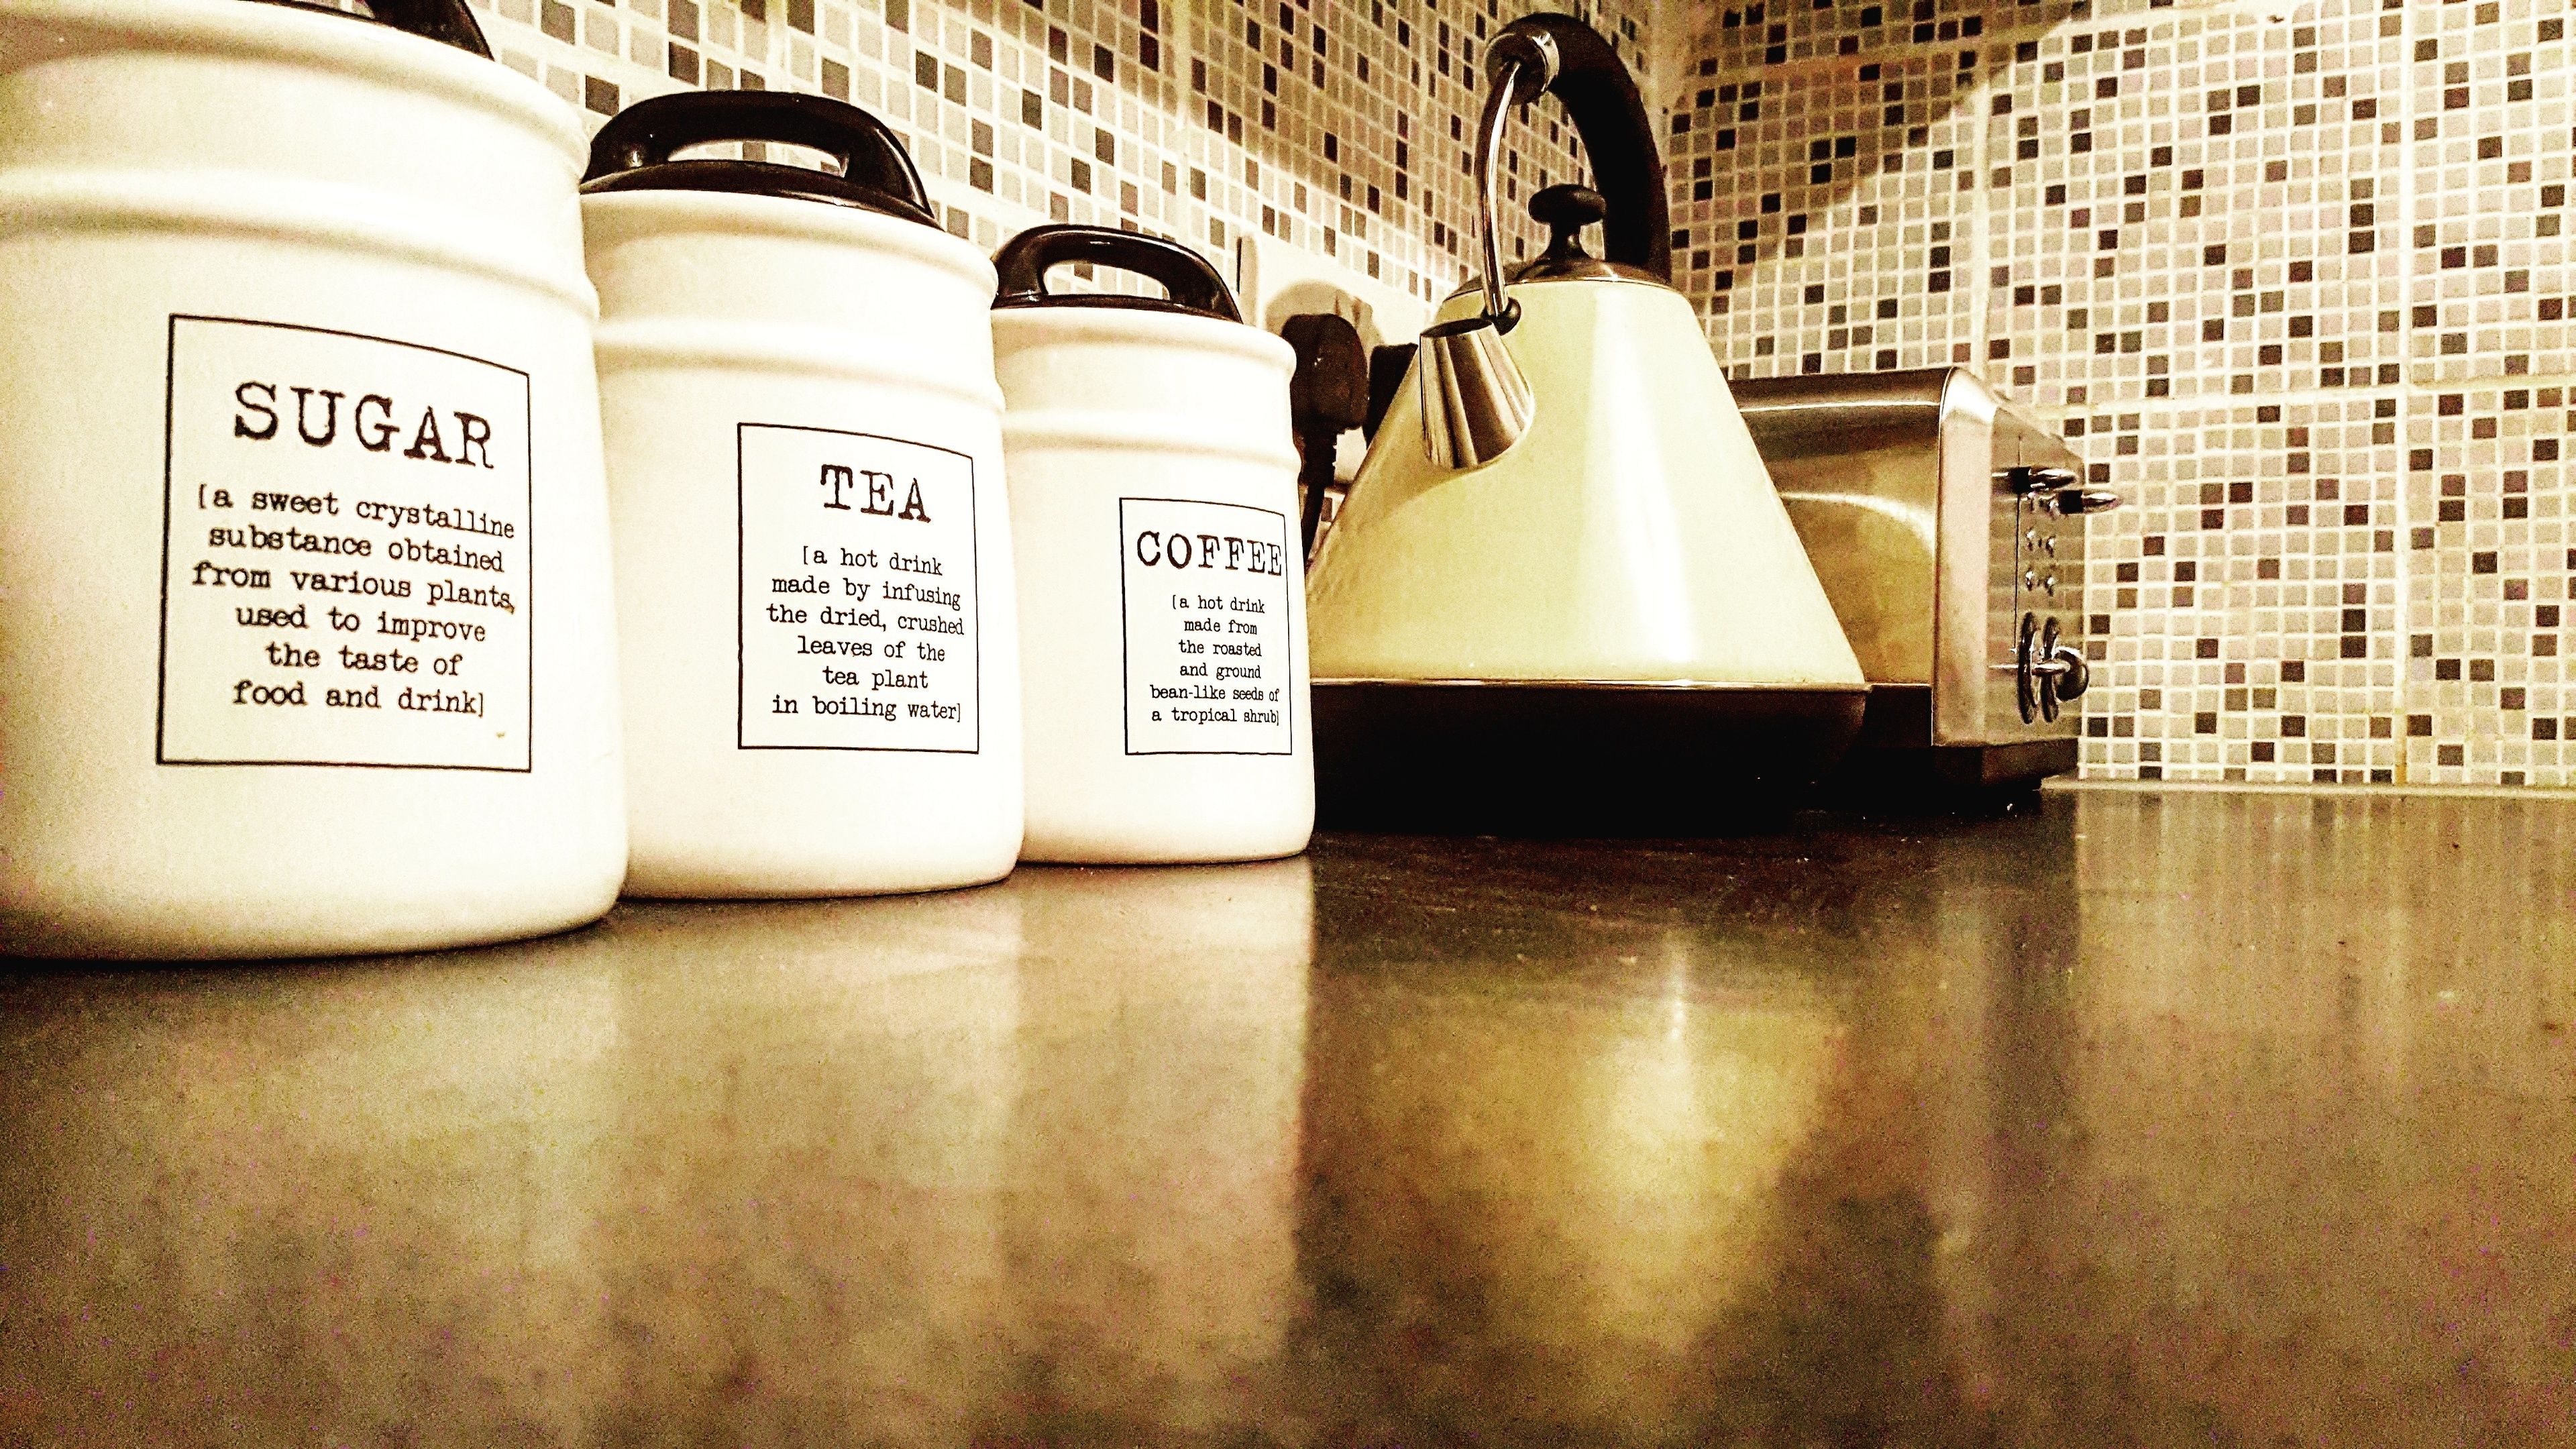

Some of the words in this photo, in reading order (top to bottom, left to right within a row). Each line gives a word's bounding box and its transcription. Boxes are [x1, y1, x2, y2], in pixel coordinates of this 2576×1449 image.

[233, 380, 494, 470] SUGAR
[820, 464, 932, 524] TEA
[251, 492, 339, 516] sweet
[356, 501, 515, 539] crystalline
[209, 524, 372, 557] substance
[388, 537, 504, 573] obtained
[840, 547, 878, 568] hot
[889, 552, 943, 576] drink
[1136, 530, 1282, 577] COFFEE
[192, 560, 271, 589] from
[289, 570, 411, 598] various
[426, 579, 515, 614] plants,
[771, 574, 830, 594] made
[842, 577, 871, 602] by
[882, 580, 961, 612] infusing
[1197, 594, 1224, 610] hot
[1230, 596, 1265, 614] drink
[235, 603, 309, 629] used
[327, 606, 360, 633] to
[376, 610, 486, 643] improve
[765, 603, 808, 624] the
[820, 606, 886, 632] dried,
[898, 615, 965, 636] crushed
[1183, 617, 1221, 633] made
[1228, 619, 1257, 635] from
[265, 641, 321, 668] the
[337, 645, 419, 674] taste
[433, 653, 464, 676] of
[797, 635, 873, 657] leaves
[883, 641, 906, 659] of
[916, 641, 945, 662] the
[1178, 639, 1205, 654] the
[1212, 642, 1263, 657] roasted
[822, 665, 860, 686] tea
[871, 669, 928, 691] plant
[1179, 662, 1208, 677] and
[1216, 664, 1262, 681] ground
[232, 680, 307, 706] food
[325, 686, 382, 709] and
[1149, 684, 1226, 700] bean-like
[1232, 686, 1264, 701] seeds
[1269, 688, 1280, 702] of
[772, 694, 799, 714] in
[812, 695, 897, 722] boiling
[1151, 710, 1163, 722] a
[1171, 706, 1238, 725] tropical
